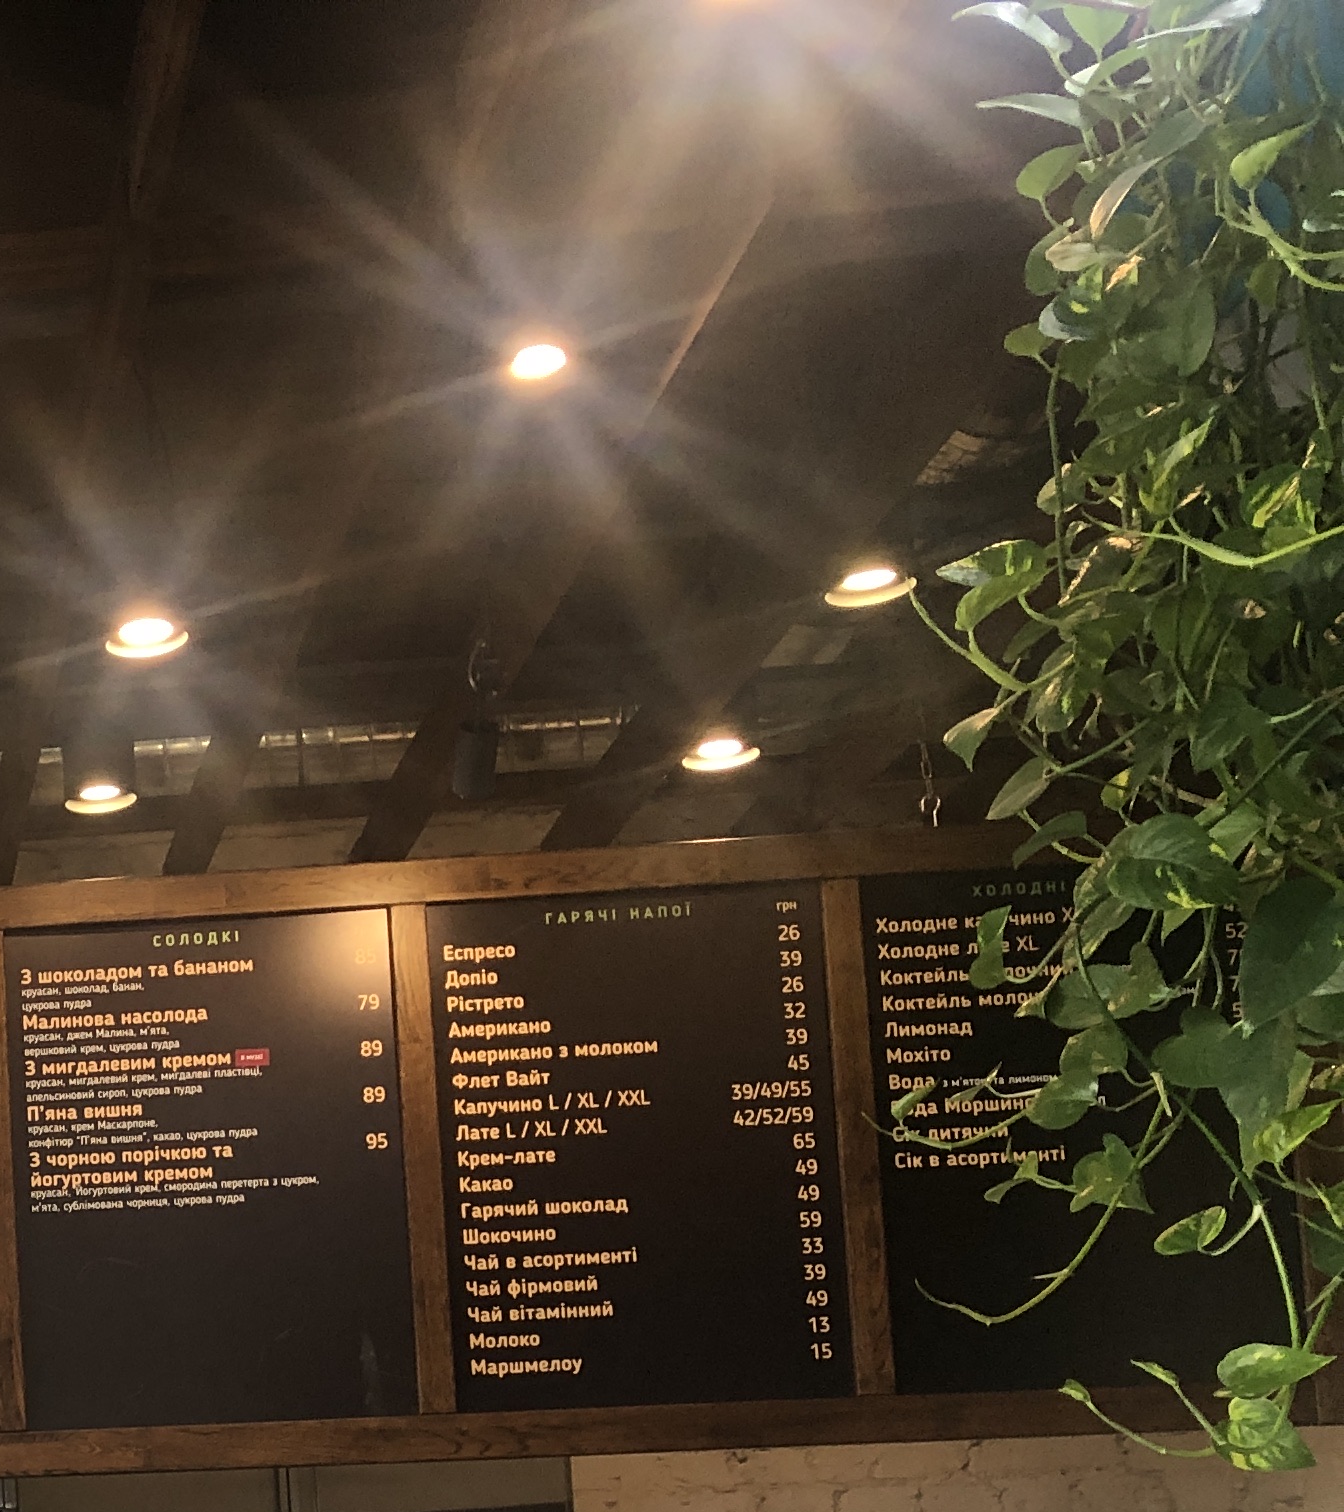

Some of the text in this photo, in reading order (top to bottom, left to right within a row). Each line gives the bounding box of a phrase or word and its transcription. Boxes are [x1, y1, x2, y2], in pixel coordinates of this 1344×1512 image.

[546, 901, 796, 924] ГАРЯЧІ НАПОЇ грн
[876, 917, 957, 933] Холодне
[153, 930, 238, 947] СОЛОДКІ
[444, 924, 800, 963] Еспресо 26
[878, 935, 1039, 960] Холодне XL
[21, 959, 253, 985] З шоколадом та бананом
[22, 1000, 92, 1012] цукрова пудра
[23, 994, 379, 1030] Малинова насолода 79
[883, 996, 971, 1011] Коктейль
[885, 1022, 972, 1037] Лимонад
[25, 1040, 382, 1076] З мигдалевим кремом 89
[886, 1048, 950, 1064] Мохіто
[452, 1054, 810, 1089] Флет Вайт 45
[889, 1074, 935, 1091] Вода
[28, 1087, 385, 1121] П'яна вишня 89
[454, 1080, 811, 1117] Капучино 39/49/55
[458, 1132, 815, 1170] Крем-лате 65
[461, 1184, 820, 1221] Гарячий шоколад 49
[468, 1290, 828, 1323] Чай вітамінний 49
[471, 1343, 832, 1378] Маршмелоу 15
